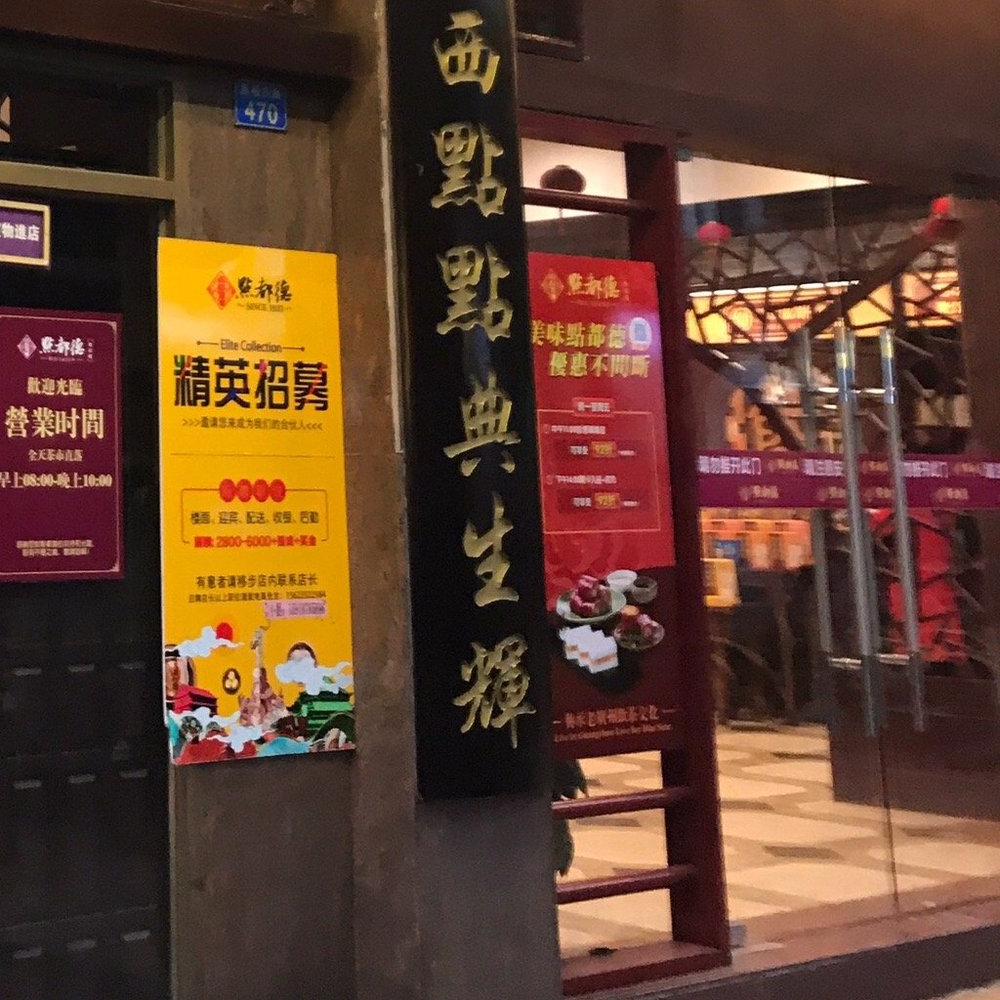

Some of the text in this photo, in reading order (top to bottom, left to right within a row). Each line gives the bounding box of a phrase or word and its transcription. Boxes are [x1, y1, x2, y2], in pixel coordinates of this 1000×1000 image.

[244, 101, 278, 125] 470
[220, 338, 283, 353] Elite Collection
[174, 355, 328, 411] 精英招募
[5, 405, 104, 439] 營業时間
